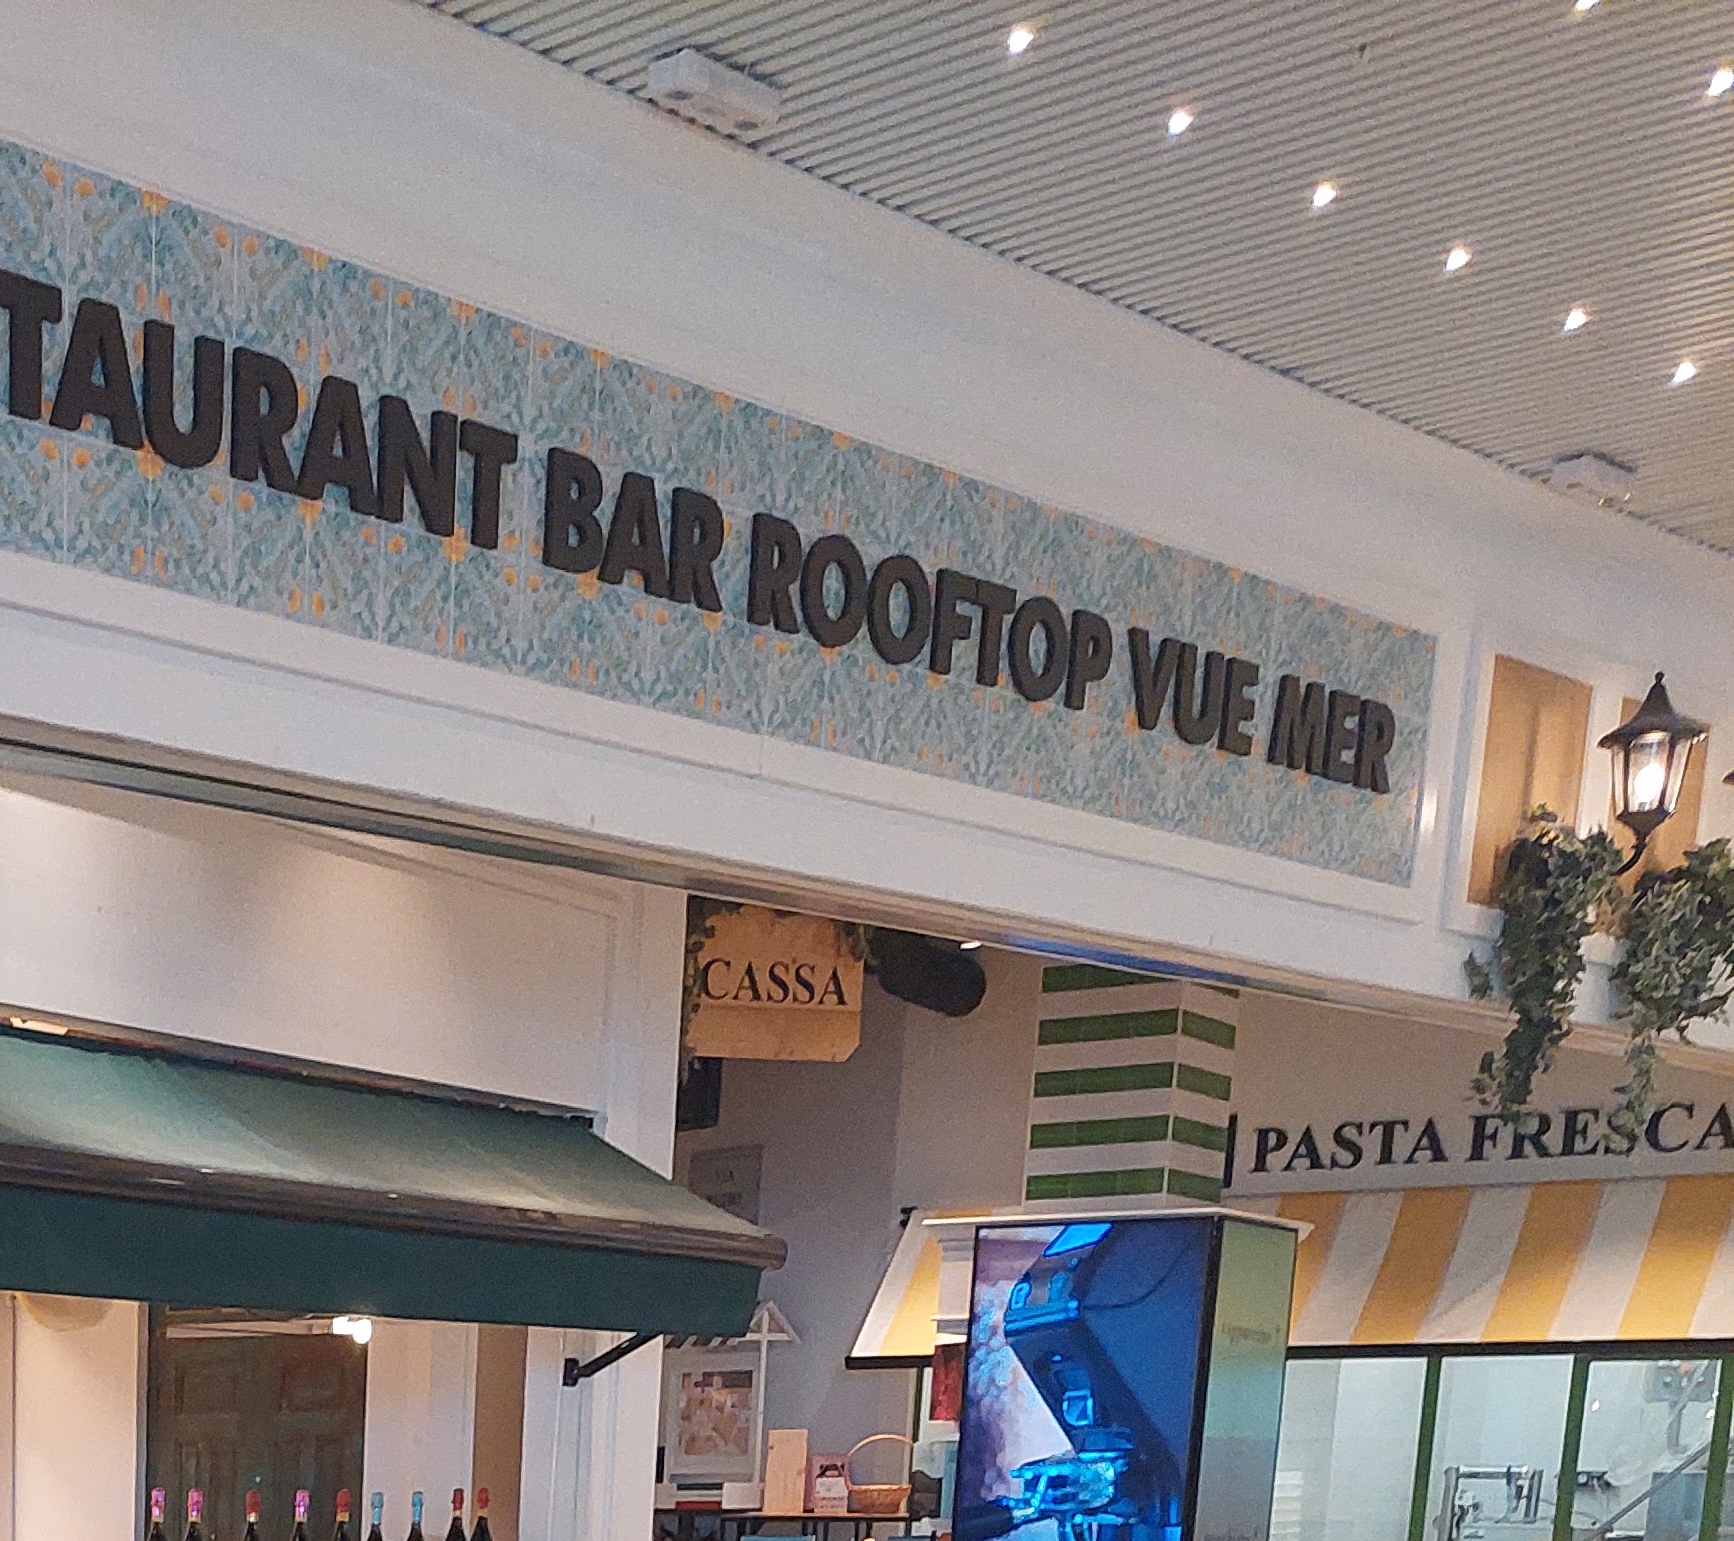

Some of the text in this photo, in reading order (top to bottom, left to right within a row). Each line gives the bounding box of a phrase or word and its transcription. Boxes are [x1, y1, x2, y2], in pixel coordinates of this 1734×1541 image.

[541, 446, 725, 613] BAR
[746, 510, 1111, 711] ROOFTOP
[1129, 626, 1260, 756] VUE
[1268, 672, 1396, 793] MER
[701, 957, 848, 1006] CASSA
[1249, 1101, 1734, 1174] PASTA FRESCA
